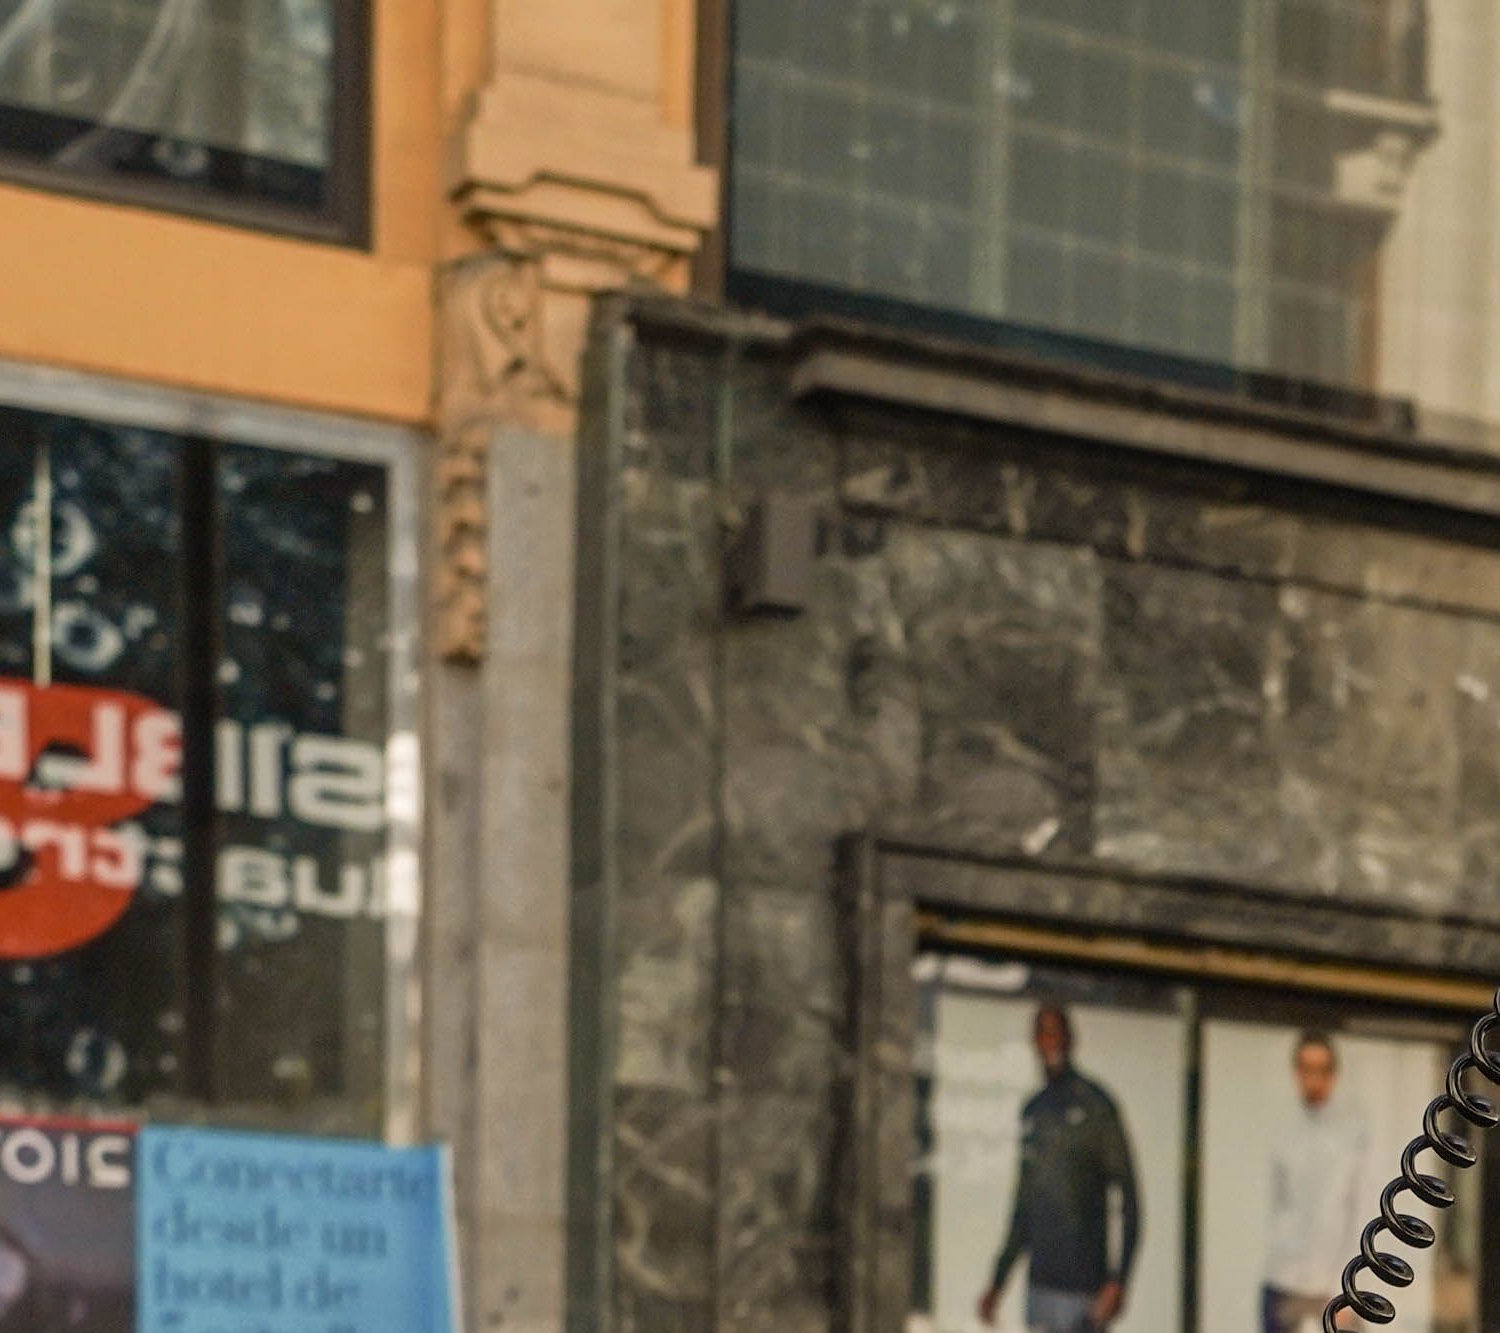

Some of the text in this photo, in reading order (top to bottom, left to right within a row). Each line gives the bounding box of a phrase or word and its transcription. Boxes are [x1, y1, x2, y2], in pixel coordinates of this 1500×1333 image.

[152, 1198, 388, 1257] desde un
[152, 1254, 360, 1313] hotel de
